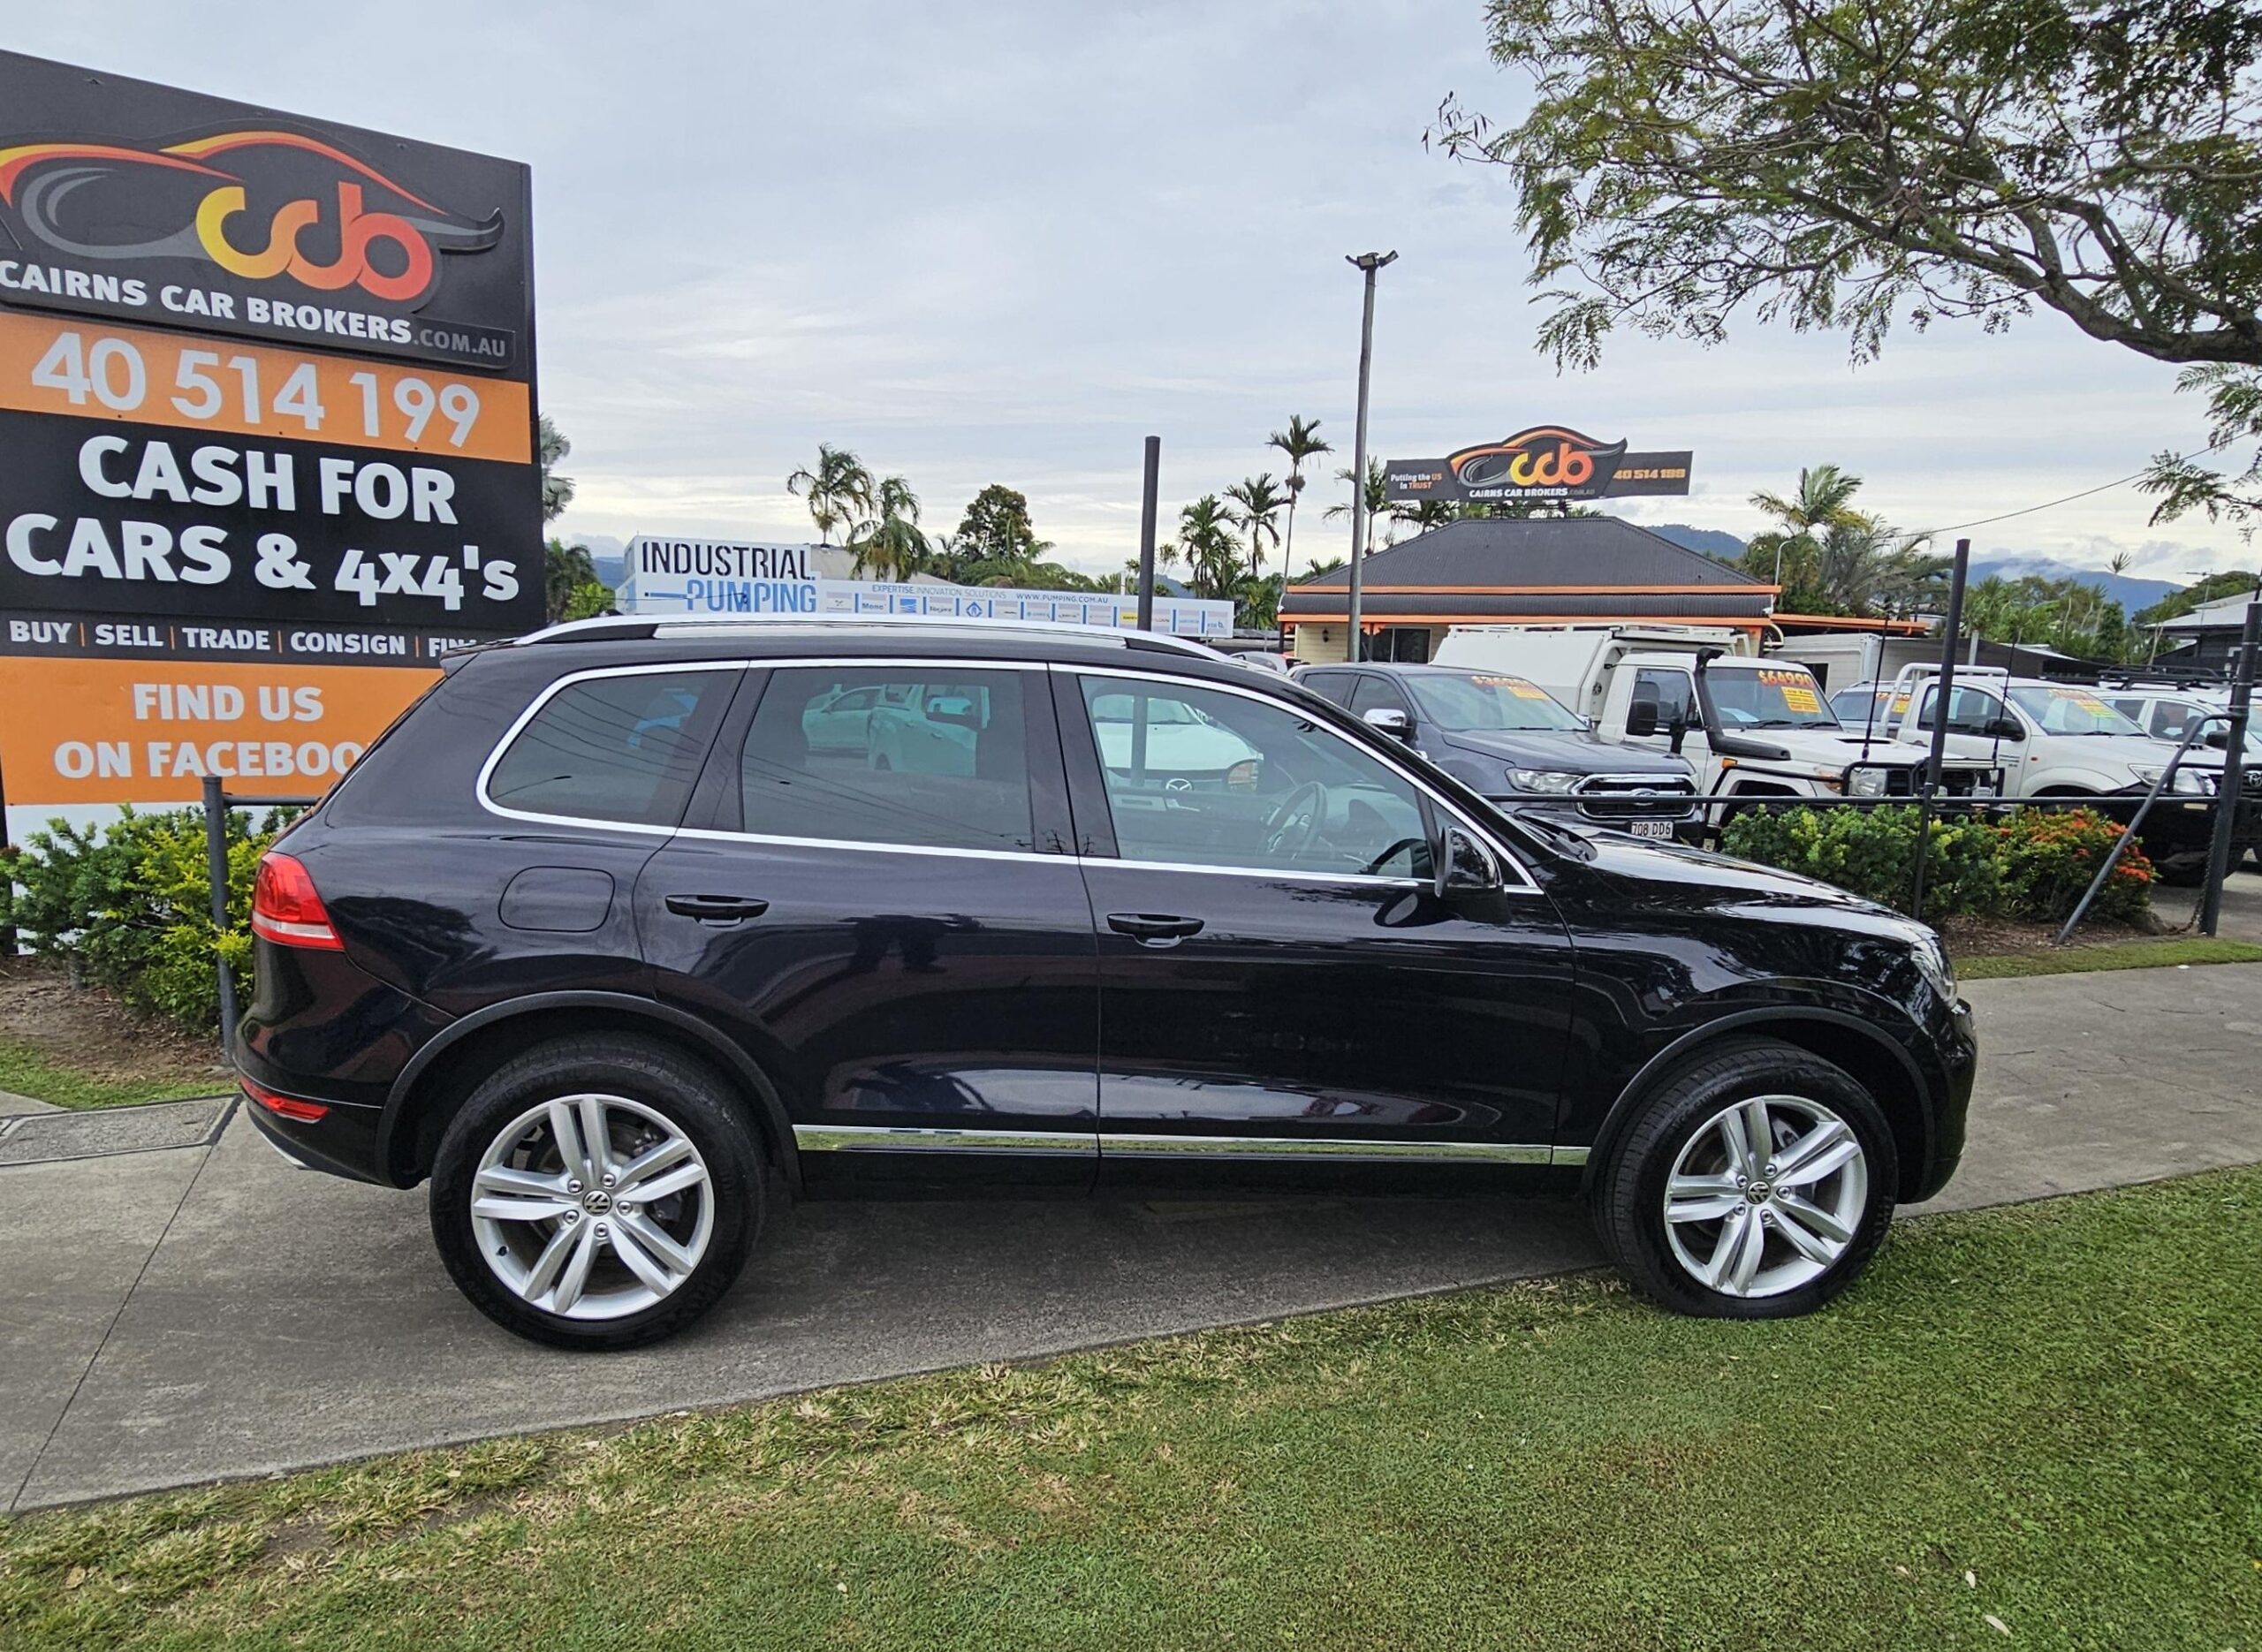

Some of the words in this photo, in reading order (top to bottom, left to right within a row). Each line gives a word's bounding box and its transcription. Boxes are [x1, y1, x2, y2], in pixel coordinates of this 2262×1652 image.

[0, 260, 148, 306] CAIRNS
[160, 285, 235, 320] CAR
[32, 331, 147, 412] 40
[171, 349, 324, 430] 514
[349, 372, 481, 448] 199
[79, 436, 296, 512] CASH
[319, 457, 459, 525] FOR
[1418, 473, 1431, 481] the
[1469, 489, 1503, 497] CAIRNS
[1504, 488, 1523, 497] CAR
[6, 513, 232, 585] CARS
[254, 533, 316, 589] &
[687, 579, 817, 613] PUMPING
[10, 620, 72, 644] BUY
[95, 624, 164, 648] SELL
[182, 627, 271, 651] TRADE
[290, 631, 406, 655] CONSIGN
[429, 637, 477, 657] FIN
[133, 683, 245, 722] FIND
[258, 686, 324, 722] US
[54, 741, 133, 778] ON
[148, 741, 369, 777] FACEBOO
